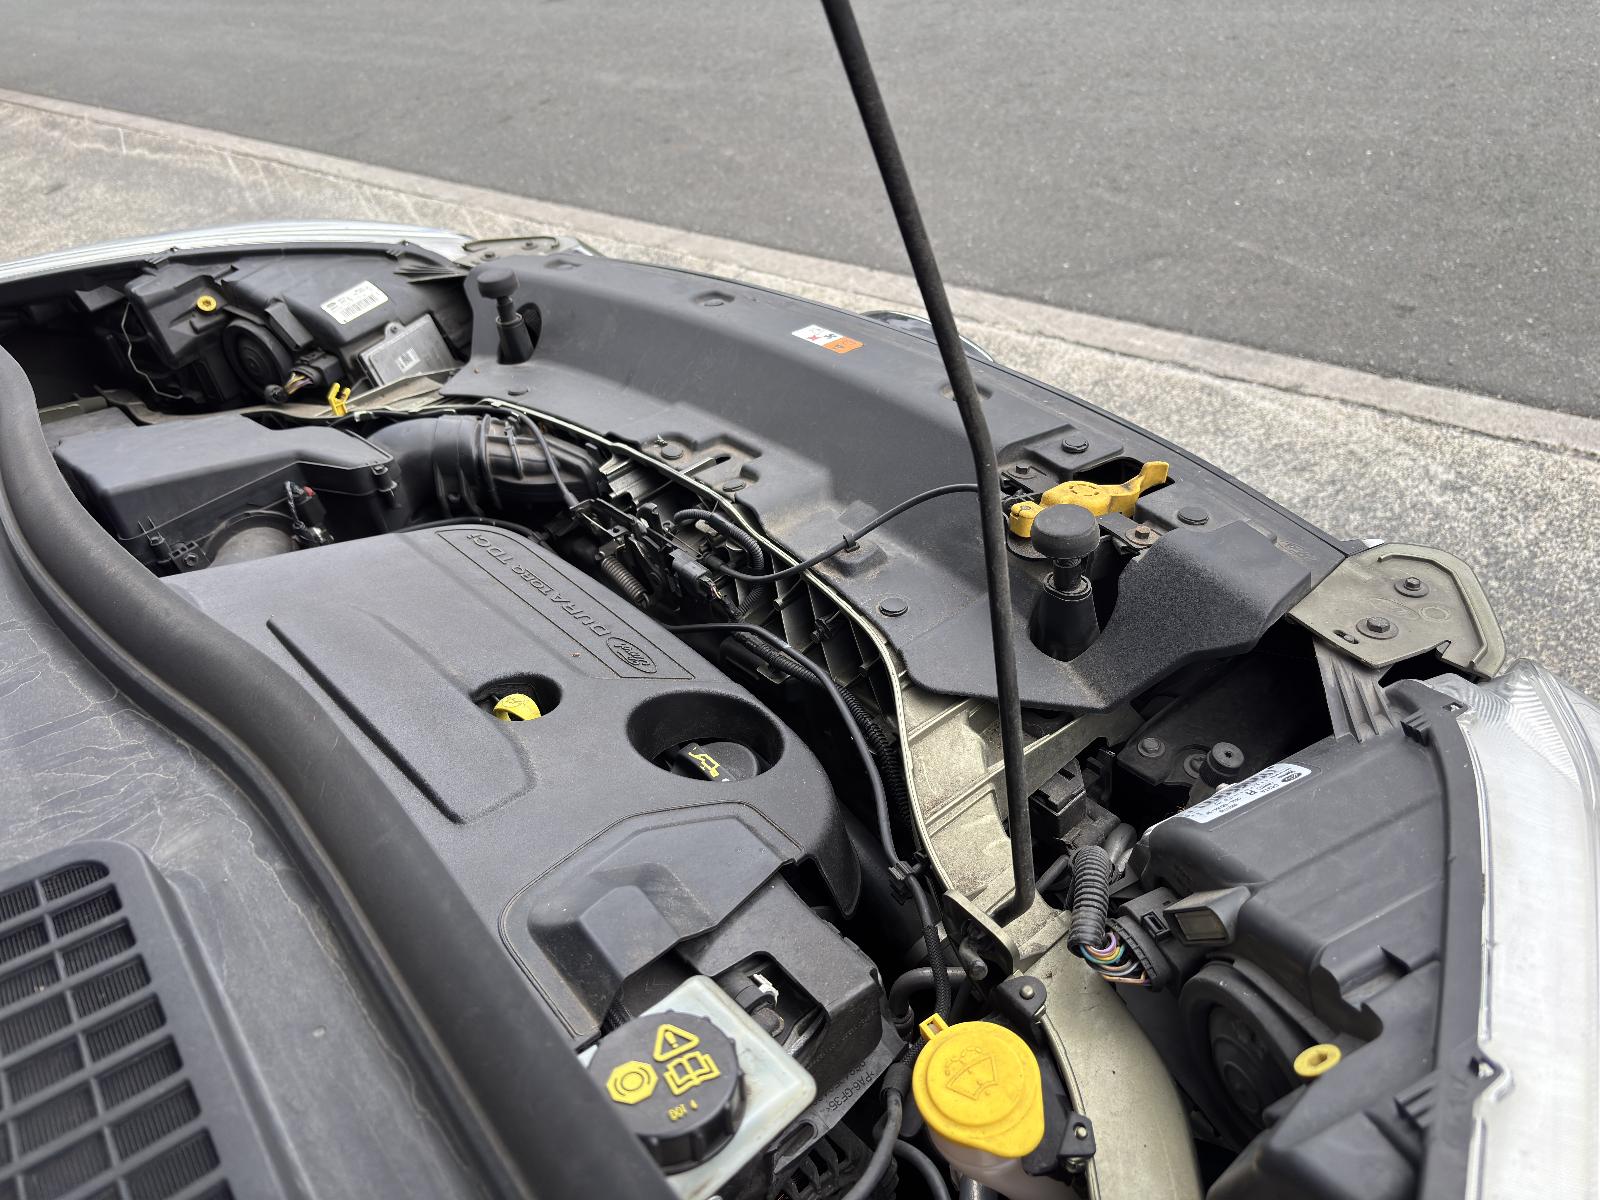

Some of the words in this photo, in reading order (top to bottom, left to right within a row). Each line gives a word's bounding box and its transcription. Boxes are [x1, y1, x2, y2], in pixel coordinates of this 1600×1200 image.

[466, 533, 515, 565] TDCi
[511, 563, 612, 638] DURATORQ
[611, 639, 654, 668] Ford
